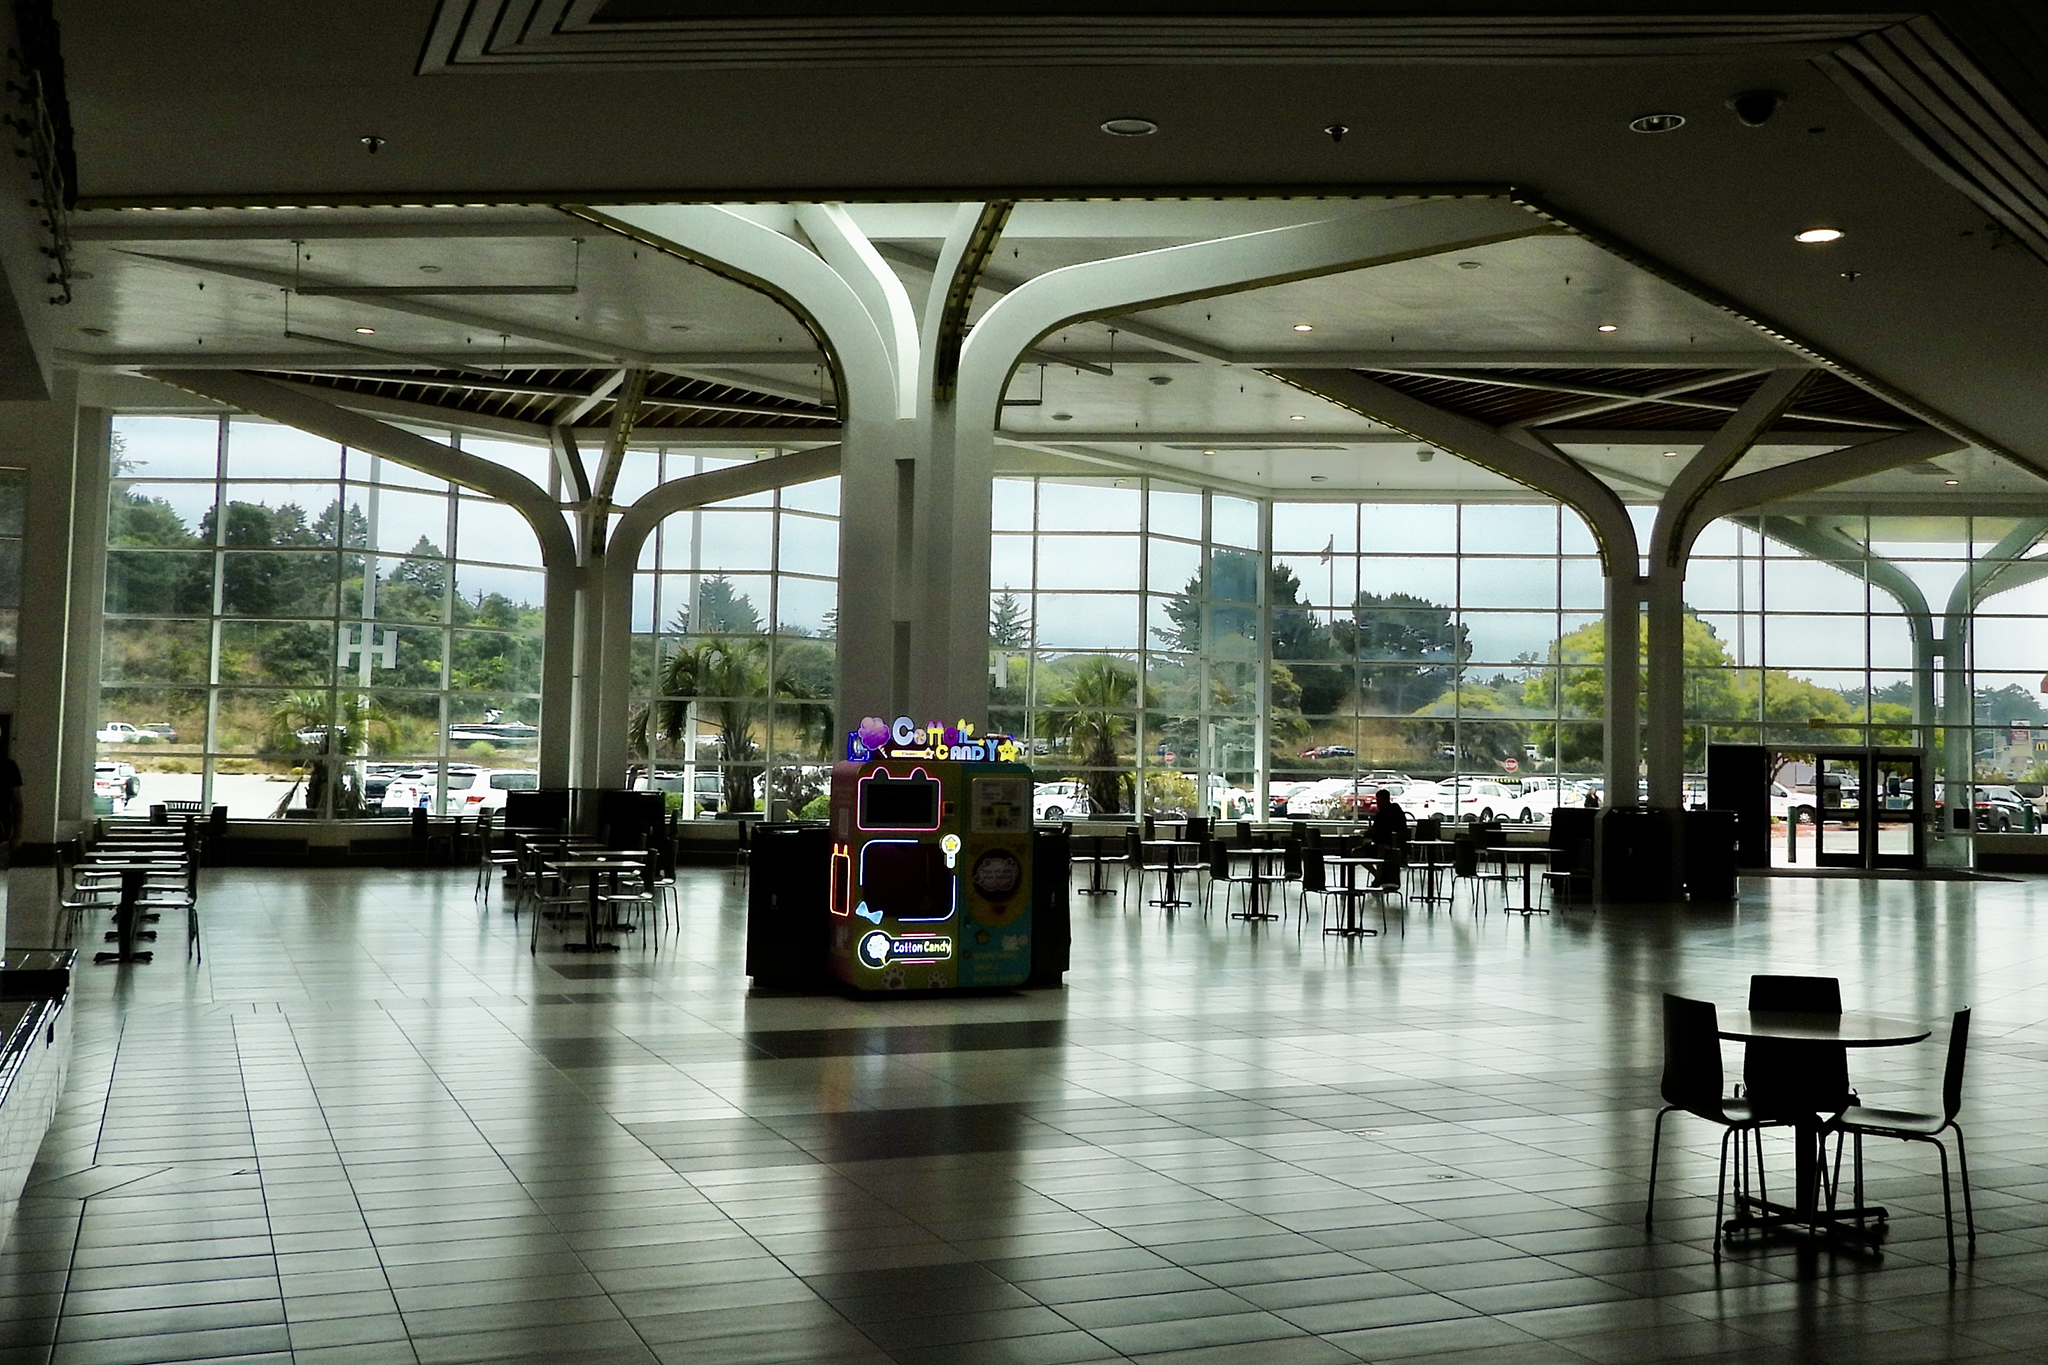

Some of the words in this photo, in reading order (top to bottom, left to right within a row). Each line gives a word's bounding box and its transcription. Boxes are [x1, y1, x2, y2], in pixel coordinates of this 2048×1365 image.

[935, 739, 999, 762] CANDY
[893, 941, 923, 953] Cotton
[924, 940, 950, 954] Candy
